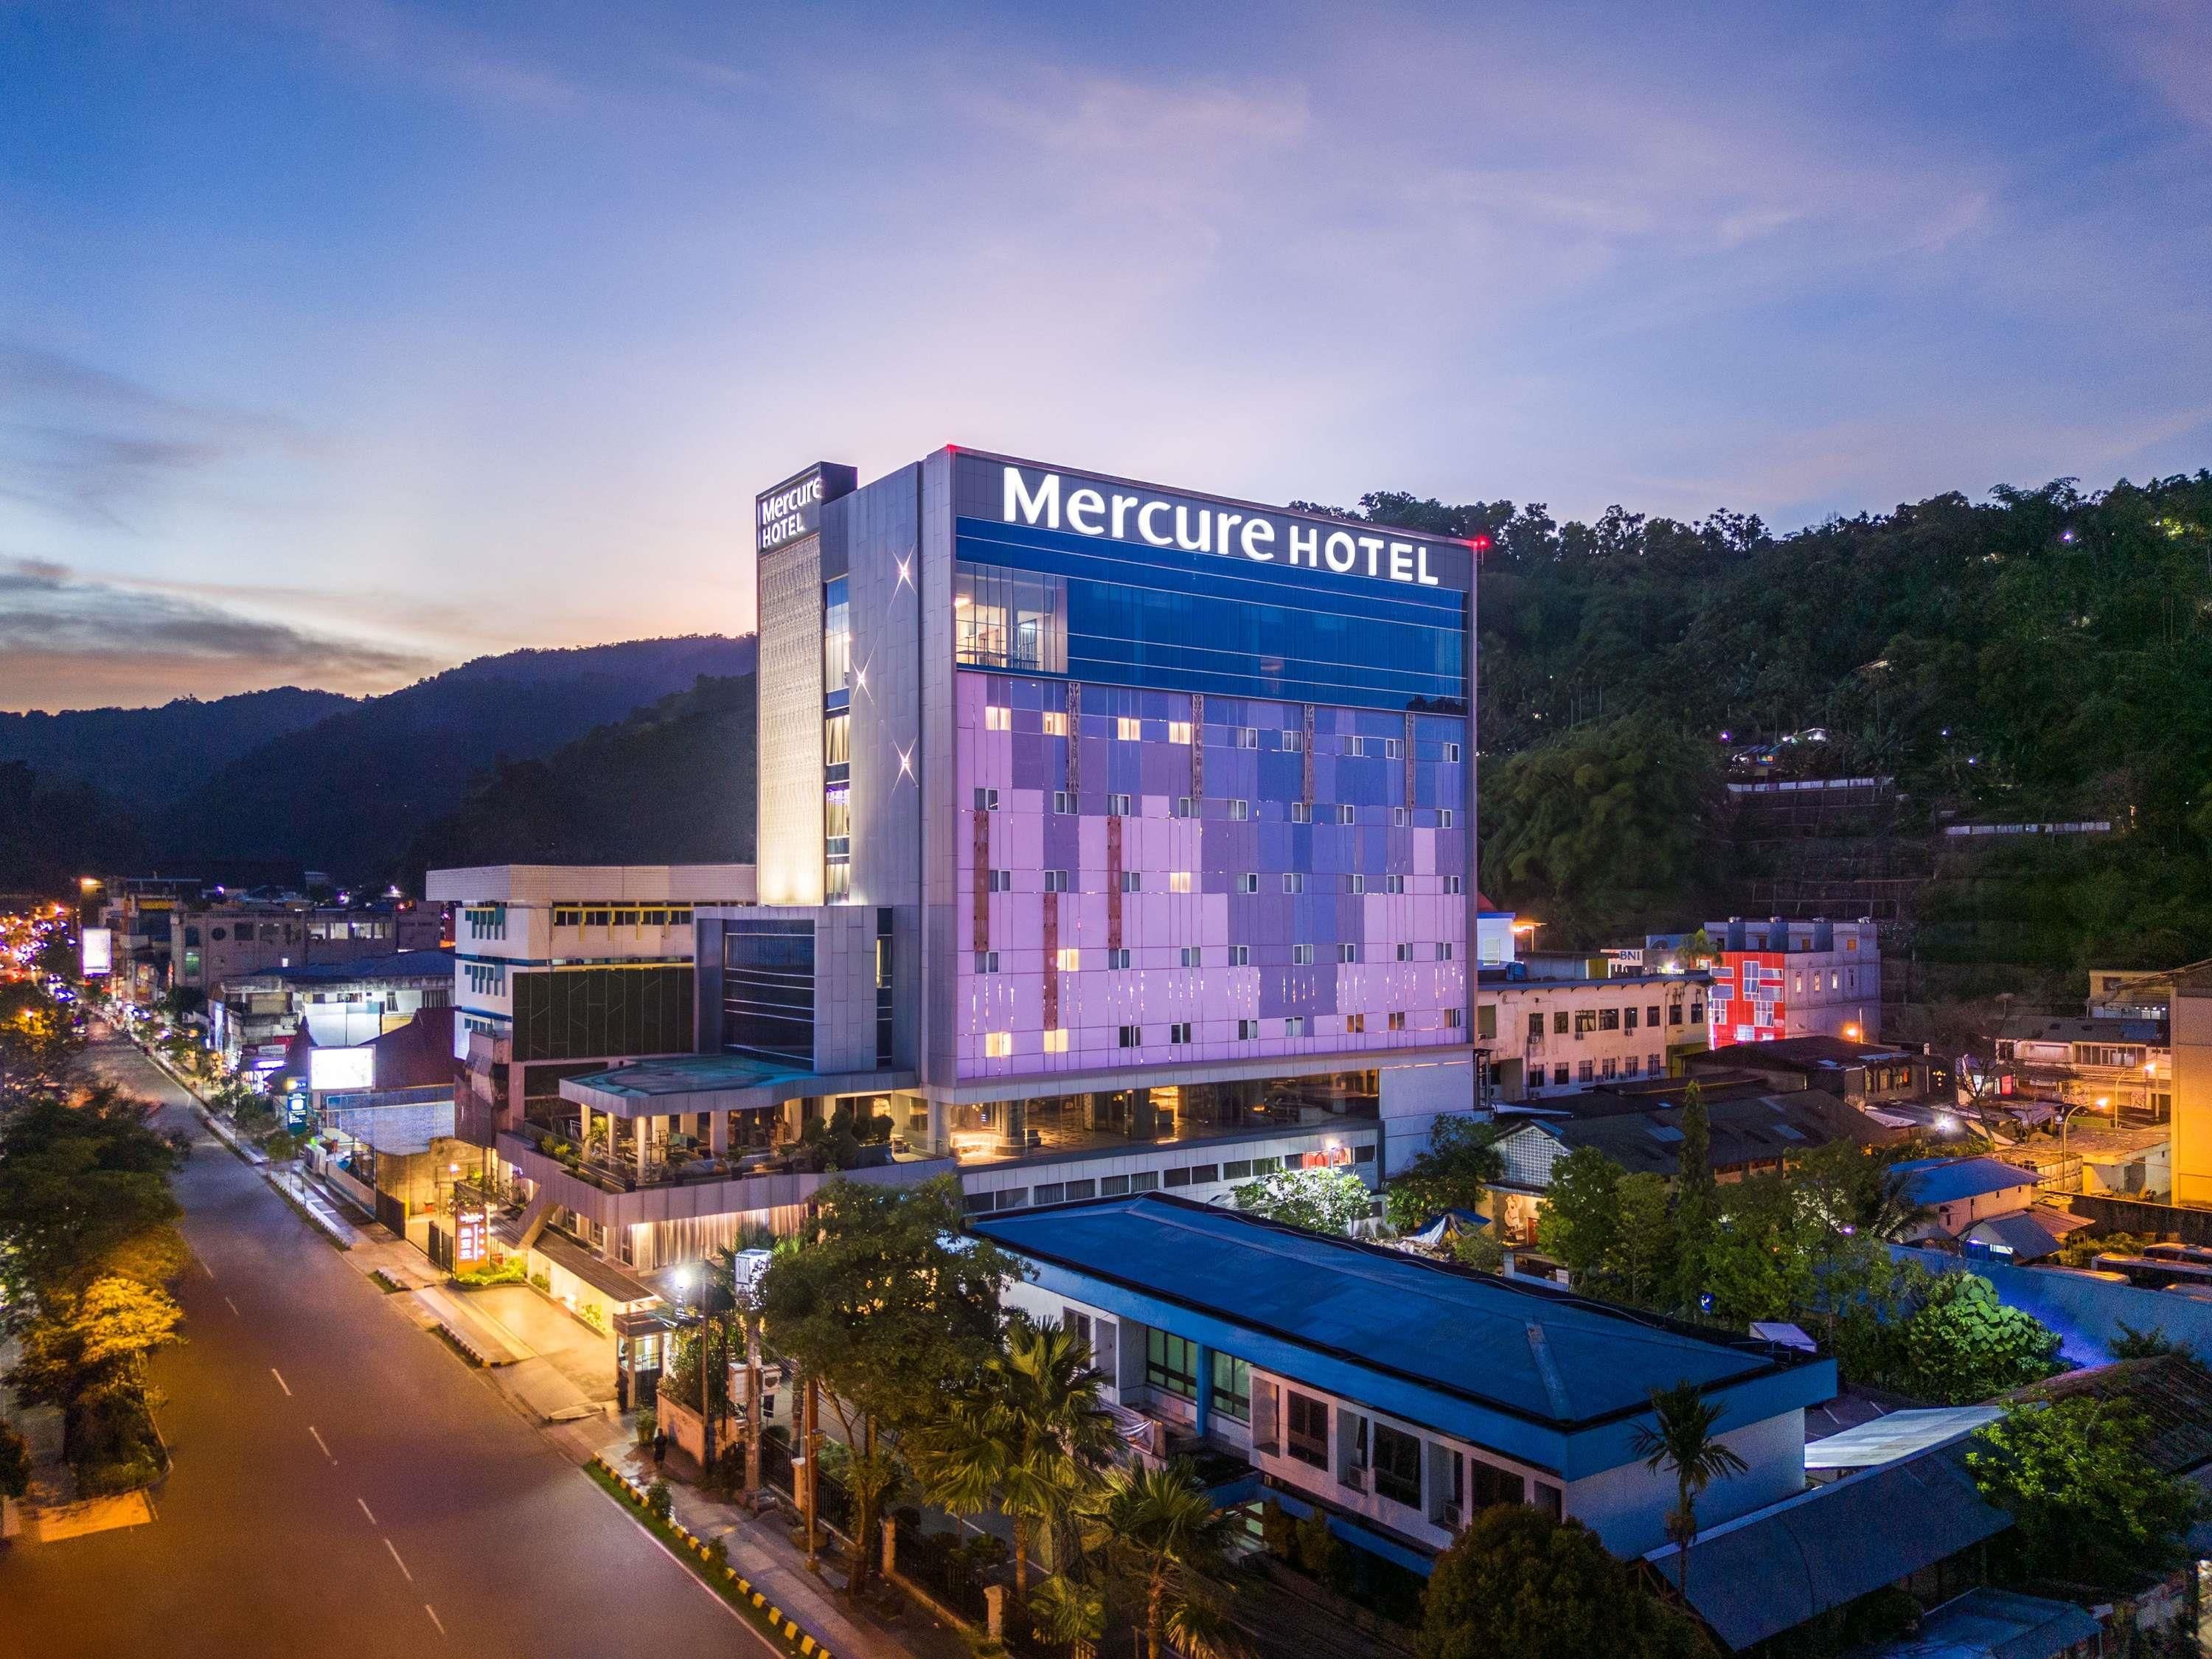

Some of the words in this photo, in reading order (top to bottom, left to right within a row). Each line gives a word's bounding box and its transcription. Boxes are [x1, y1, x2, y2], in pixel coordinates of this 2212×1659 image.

[762, 476, 821, 525] Mercure
[762, 512, 804, 548] HOTEL
[1004, 467, 1274, 561] Mercure
[1290, 525, 1439, 585] HOTEL
[1620, 951, 1640, 961] BNI
